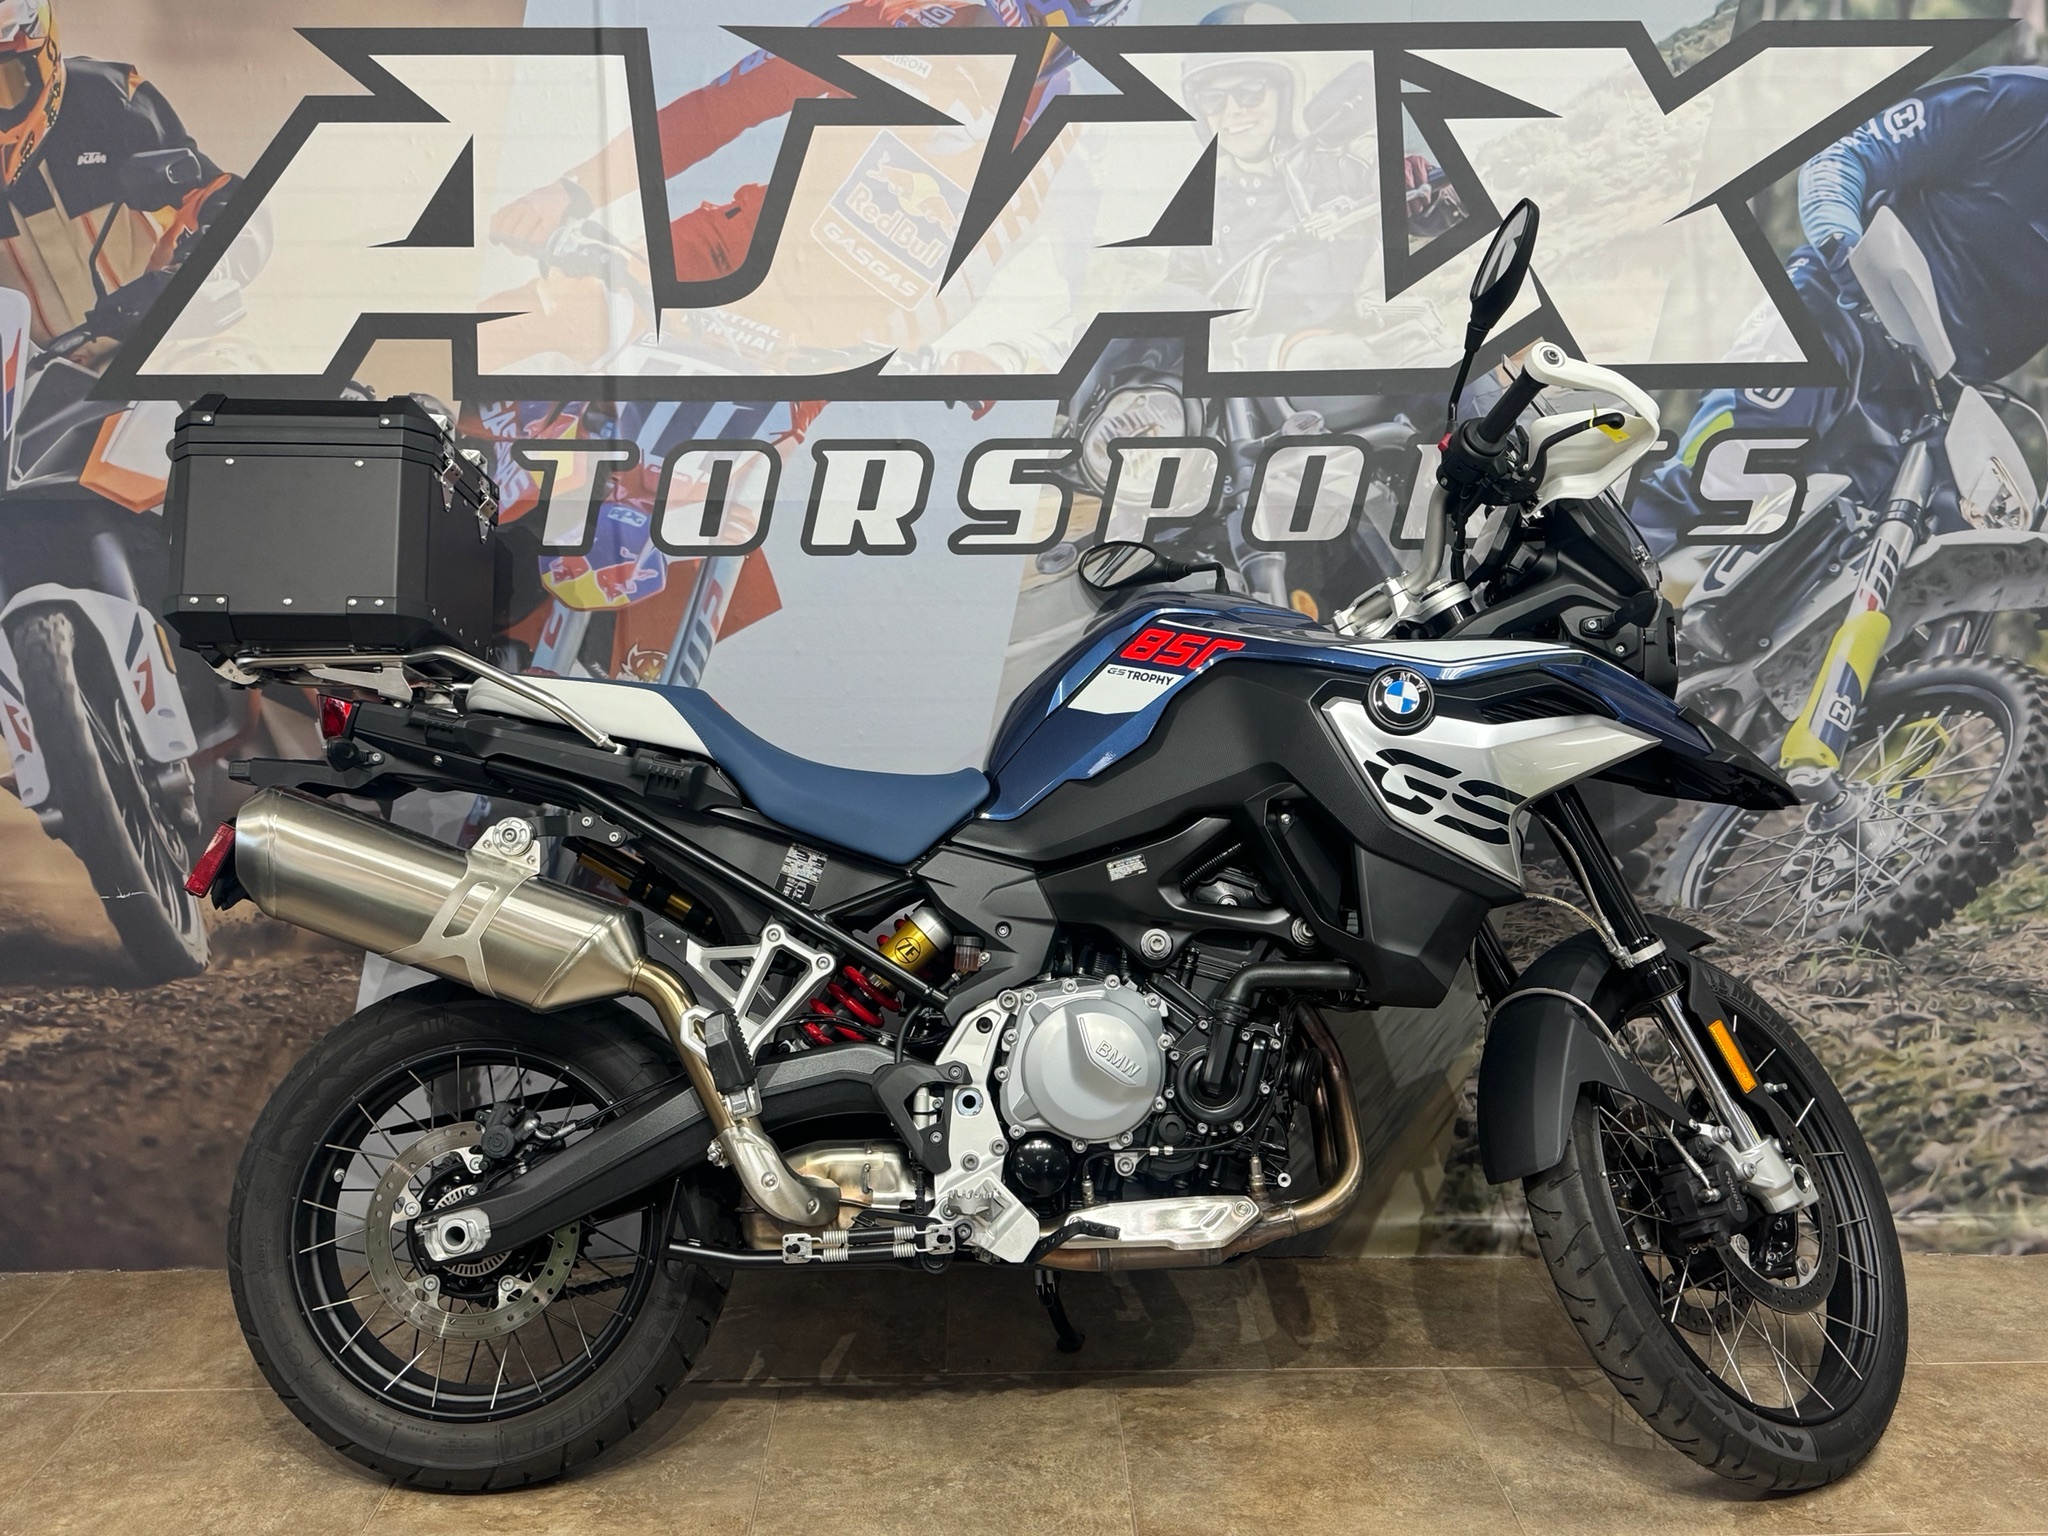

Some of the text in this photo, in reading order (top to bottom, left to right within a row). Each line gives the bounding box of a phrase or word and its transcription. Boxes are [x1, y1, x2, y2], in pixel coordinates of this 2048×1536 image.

[885, 56, 929, 75] IROH
[77, 152, 107, 165] KTM
[86, 18, 2020, 401] AJAX
[823, 222, 918, 296] GASGAS
[1107, 667, 1174, 686] GS TROPHY
[1380, 671, 1428, 694] BMW
[1363, 748, 1527, 846] GS
[895, 937, 921, 963] ZF
[1096, 1040, 1142, 1078] BMW
